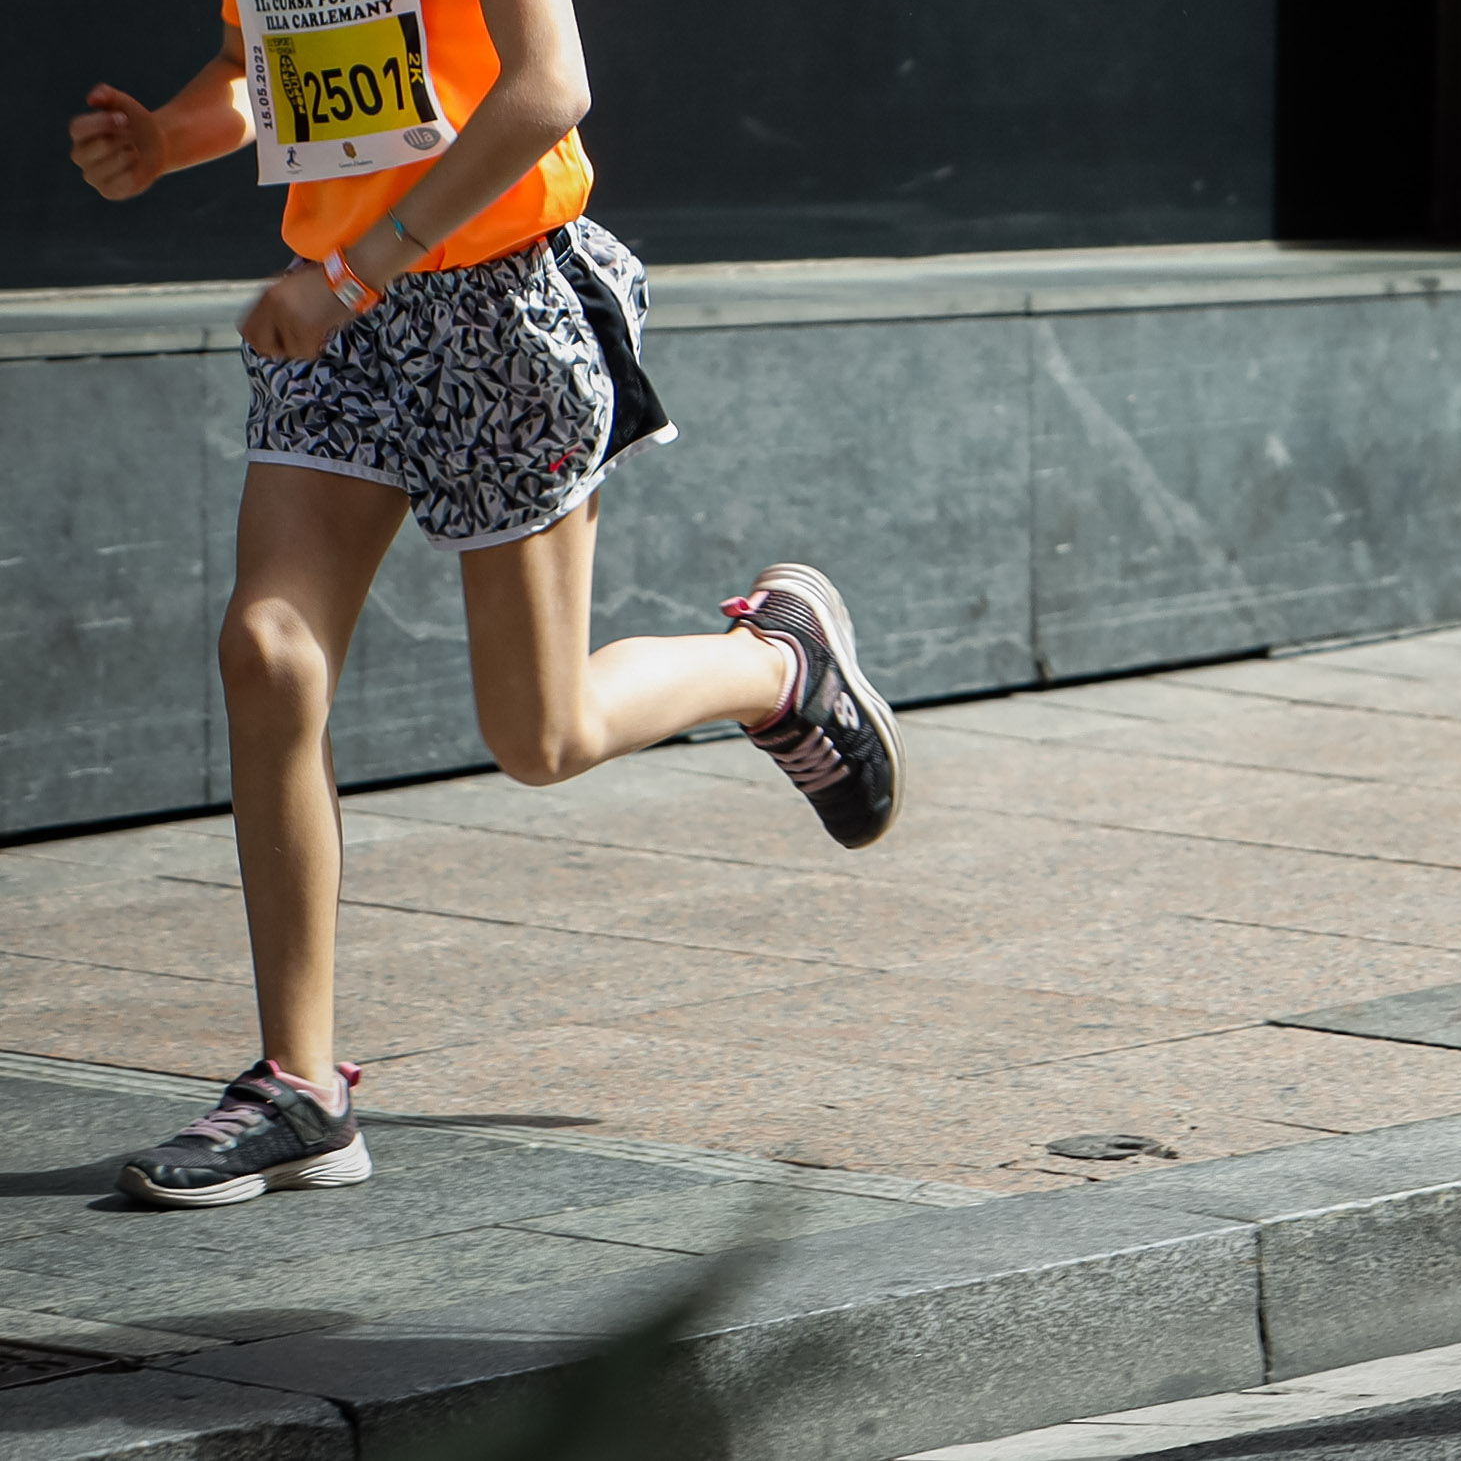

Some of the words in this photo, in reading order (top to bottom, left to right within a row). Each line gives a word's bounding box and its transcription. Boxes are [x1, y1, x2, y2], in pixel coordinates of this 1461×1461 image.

[266, 15, 290, 30] ILLA
[253, 45, 273, 131] 15.05.2022
[304, 56, 405, 125] 2501
[408, 52, 424, 84] 2K
